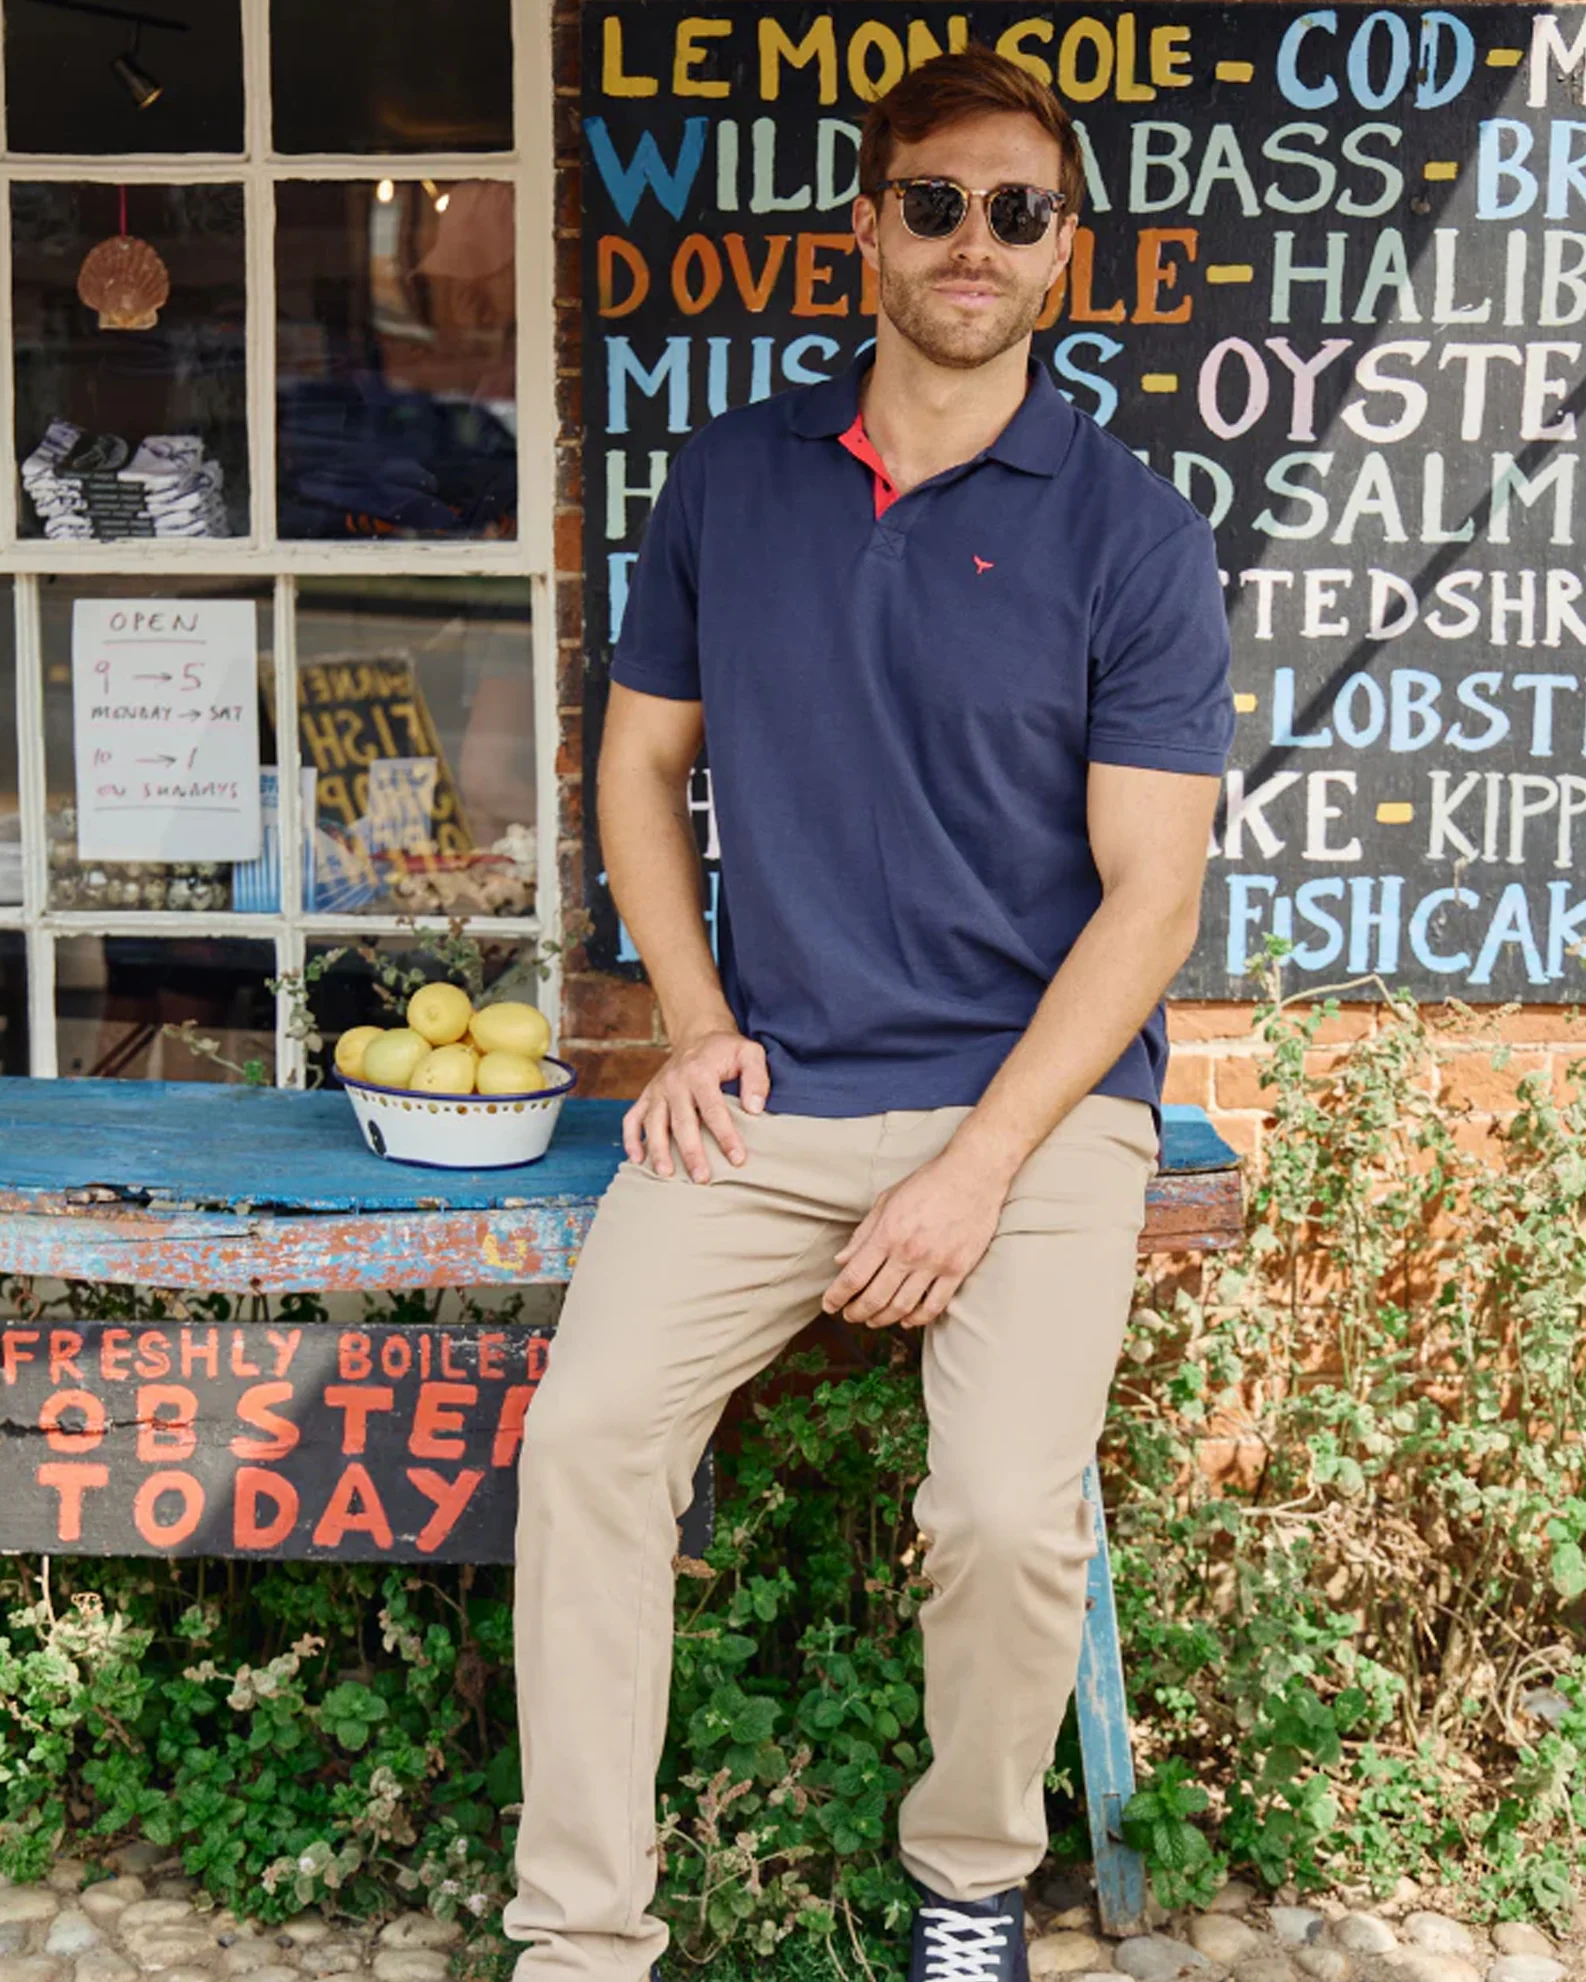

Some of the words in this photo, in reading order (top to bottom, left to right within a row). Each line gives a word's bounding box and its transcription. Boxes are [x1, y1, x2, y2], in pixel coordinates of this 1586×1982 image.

[995, 12, 1193, 102] SOLE
[1276, 10, 1475, 109] COD
[584, 117, 862, 226] WILD
[597, 234, 880, 318] DOVE
[1268, 228, 1586, 326] HALIB
[1198, 337, 1582, 443] OYSTE
[109, 612, 199, 632] OPEN
[1218, 568, 1419, 641] TED
[91, 705, 173, 721] MONDAY
[209, 705, 243, 722] SAT
[94, 660, 111, 695] 9
[179, 662, 206, 691] 5
[1270, 667, 1586, 758] LOBST
[2, 1327, 302, 1386] FRESHLY
[337, 1331, 550, 1381] BOILED
[36, 1462, 485, 1553] TODAY
